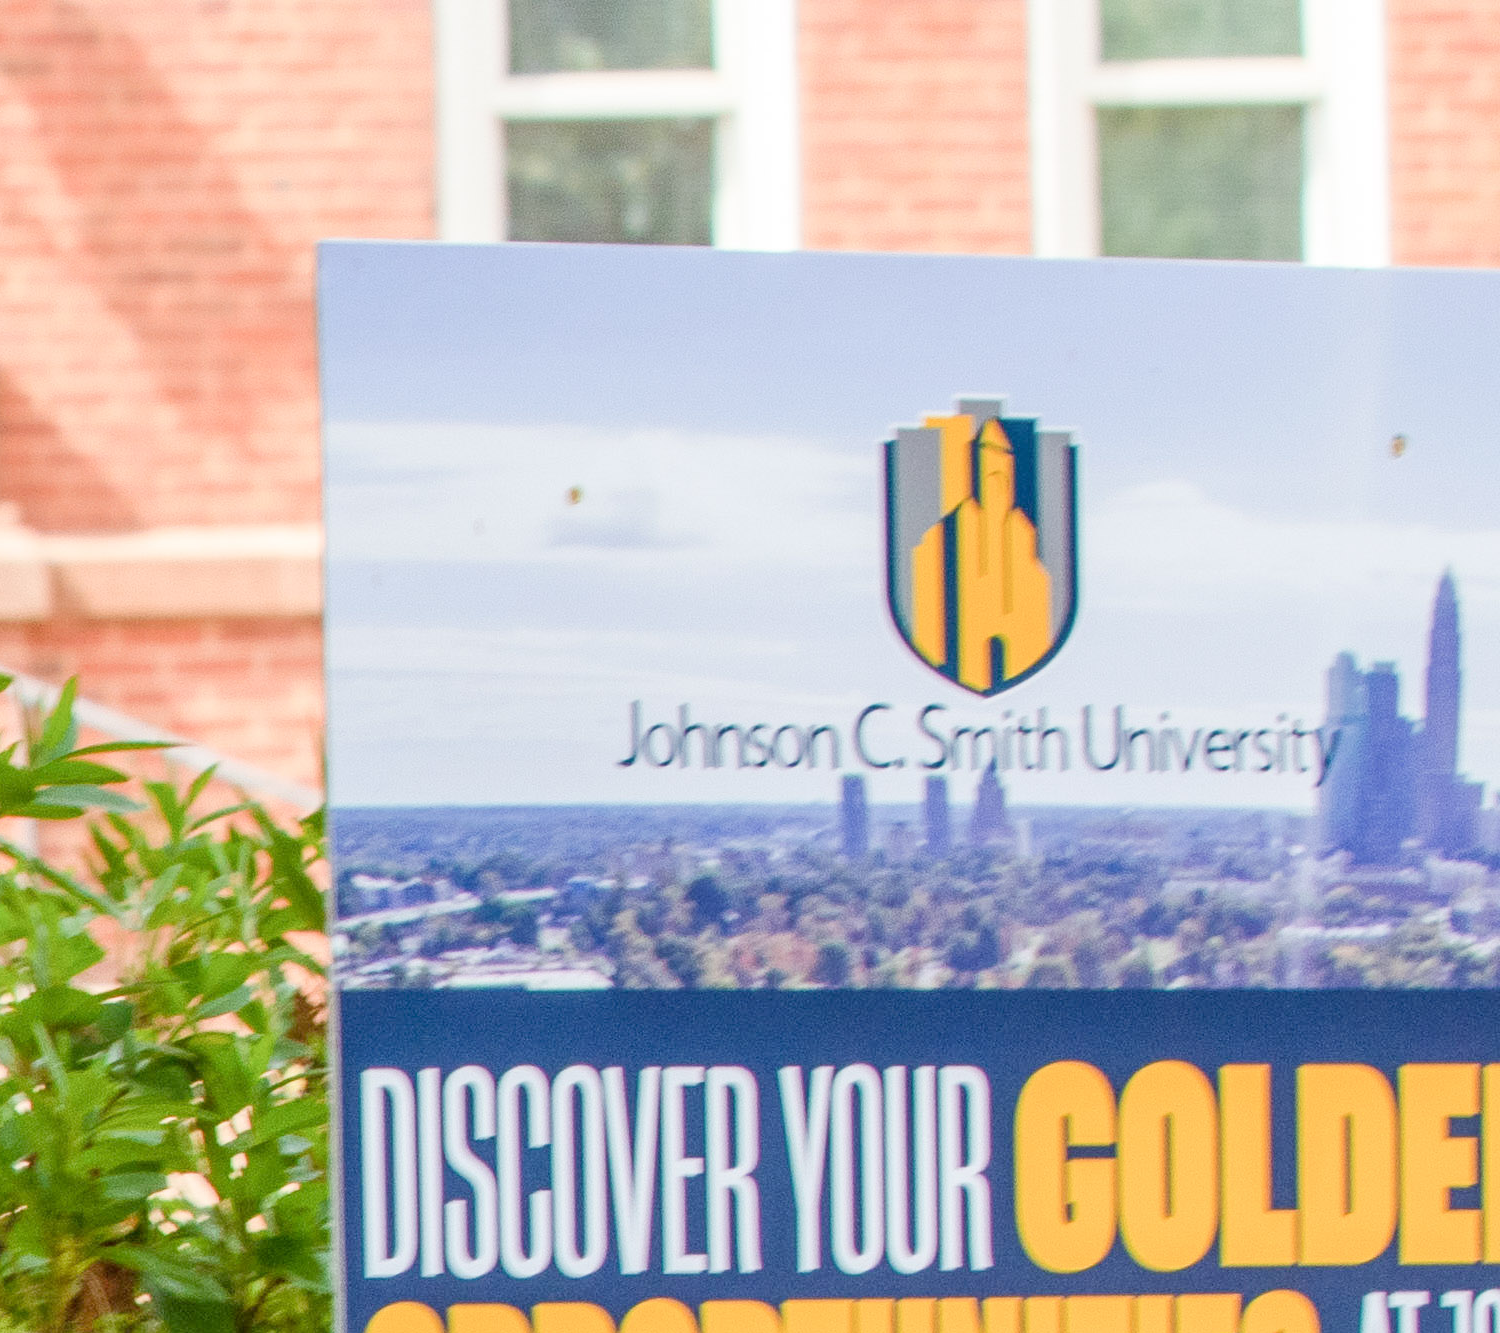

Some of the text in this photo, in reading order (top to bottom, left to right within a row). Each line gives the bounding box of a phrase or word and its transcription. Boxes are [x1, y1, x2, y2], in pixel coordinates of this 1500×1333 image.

[616, 700, 1342, 788] Johnson C. Smith University
[360, 1059, 1500, 1279] DISCOVER YOUR GOLDE
